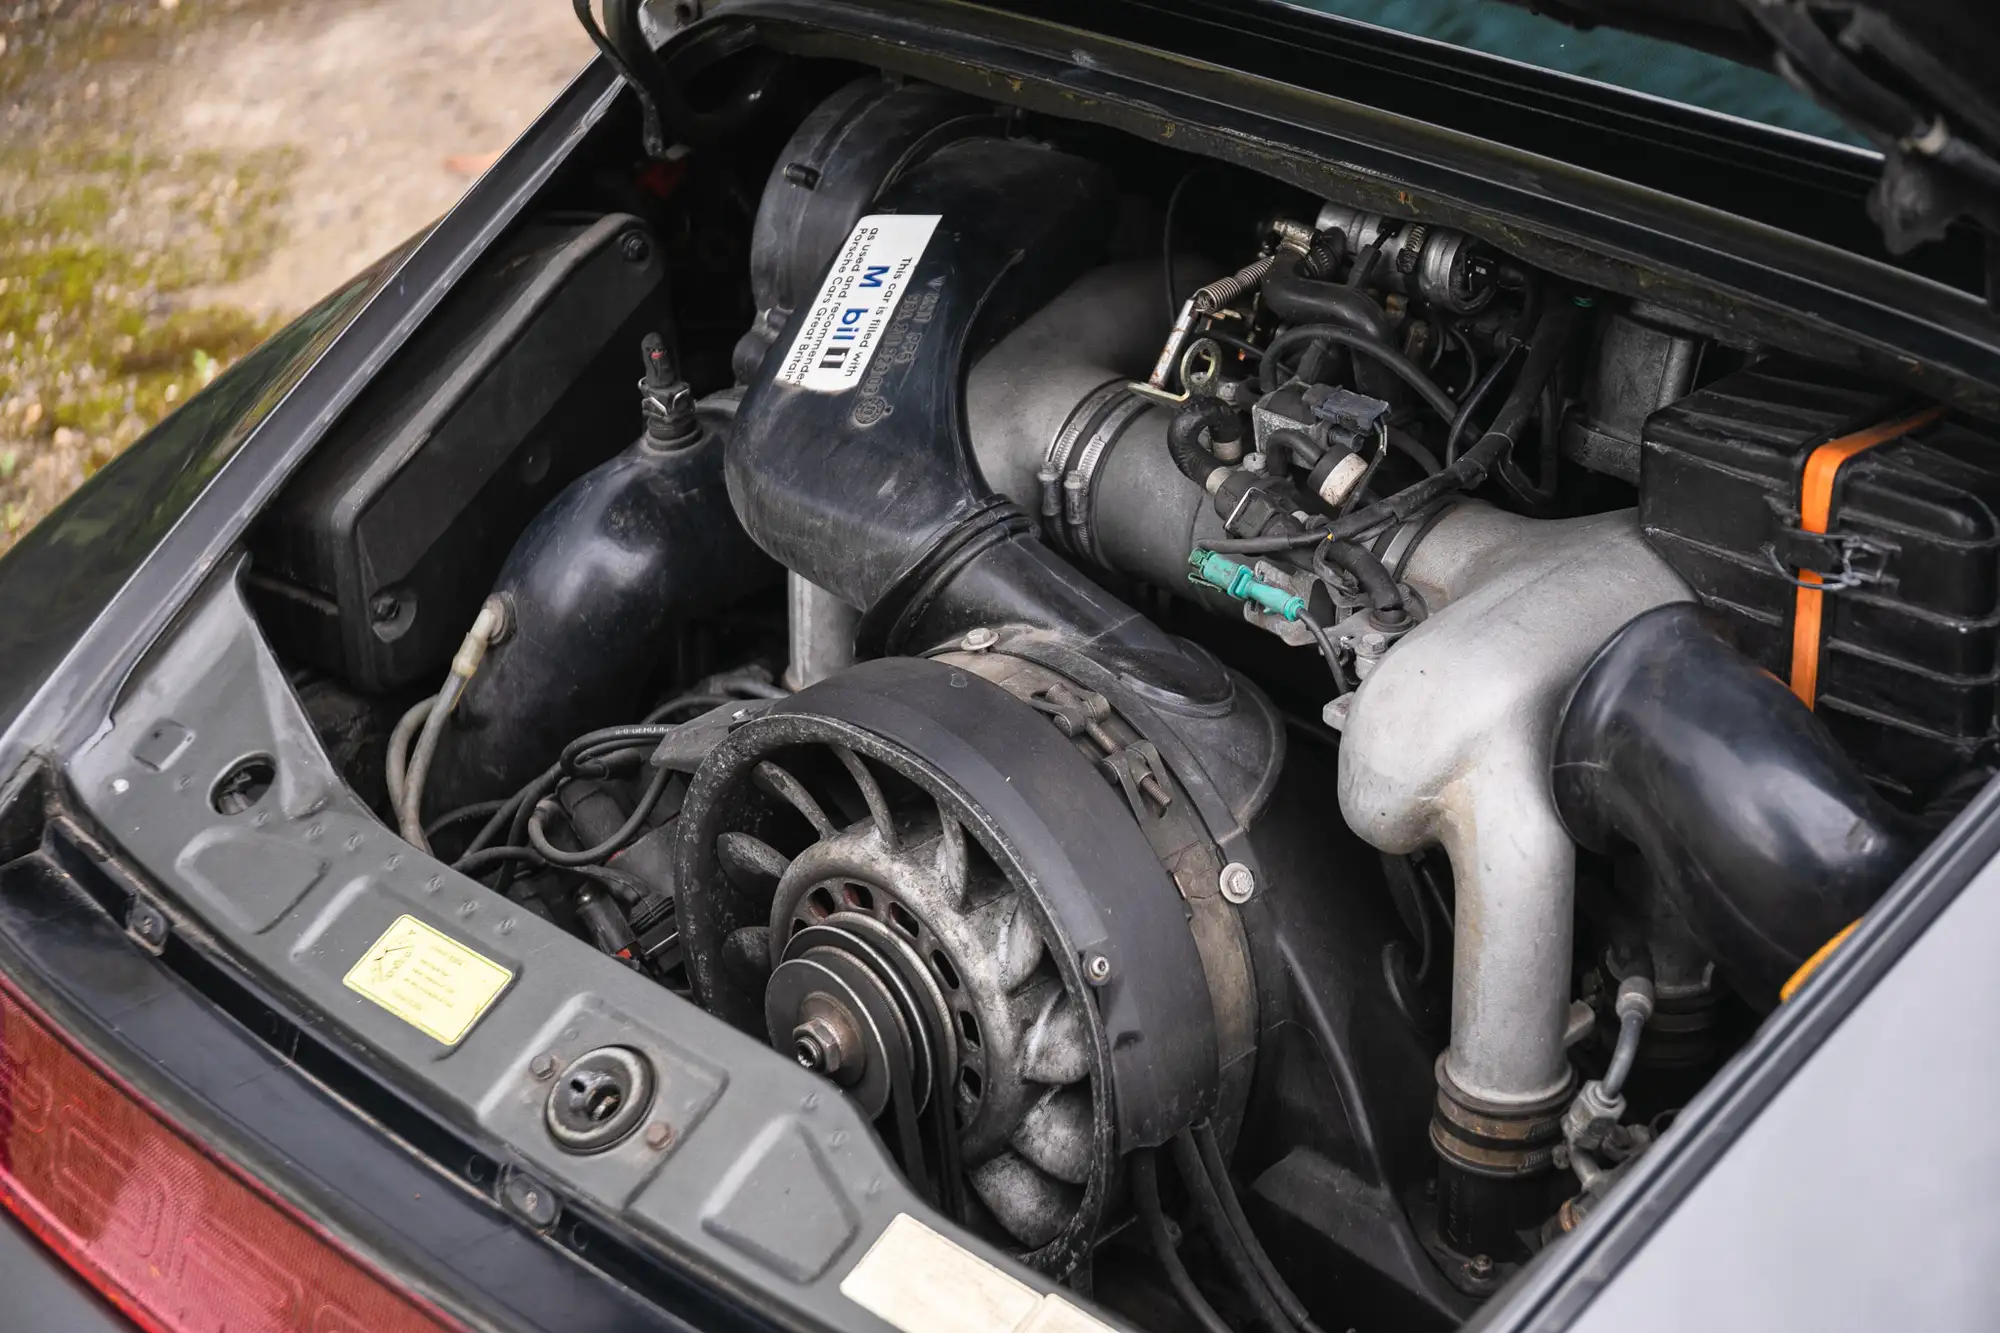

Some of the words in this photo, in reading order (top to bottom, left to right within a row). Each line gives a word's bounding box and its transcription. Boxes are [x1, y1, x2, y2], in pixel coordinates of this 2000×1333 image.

[867, 227, 878, 240] as
[838, 228, 868, 273] Porsche
[851, 244, 870, 273] used
[893, 257, 912, 279] This
[822, 276, 842, 304] Cars
[837, 275, 855, 299] and
[882, 283, 896, 303] car
[804, 307, 827, 340] Great
[875, 306, 888, 315] is
[859, 319, 881, 348] filled
[844, 351, 861, 377] with
